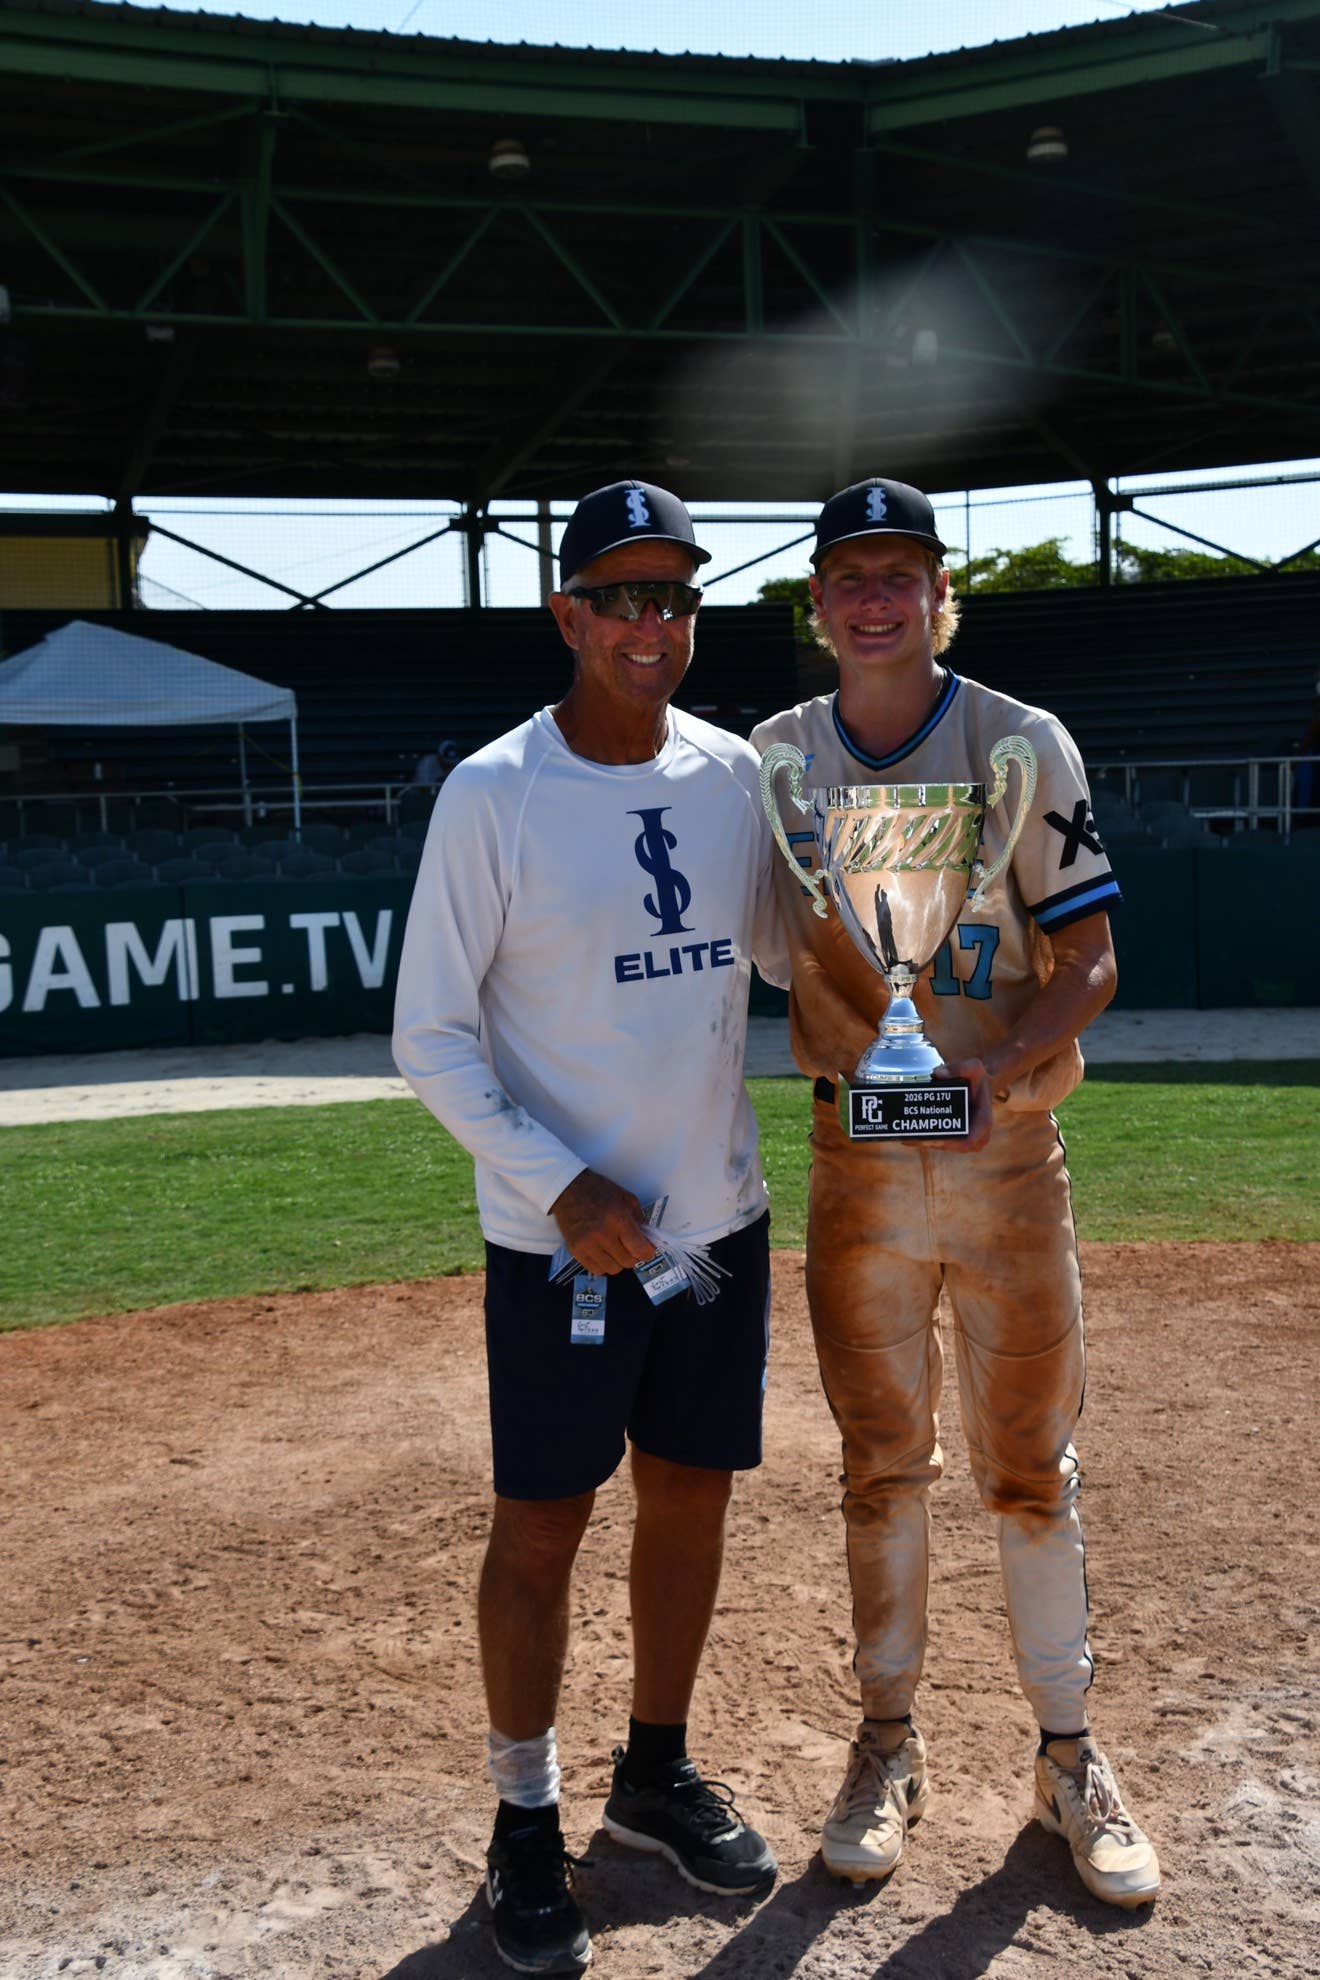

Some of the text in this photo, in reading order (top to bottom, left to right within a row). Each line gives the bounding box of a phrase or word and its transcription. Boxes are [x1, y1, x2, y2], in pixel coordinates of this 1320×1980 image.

[0, 910, 393, 1013] AME.TV
[614, 938, 735, 983] ELITE
[928, 924, 999, 1000] 17
[904, 1092, 951, 1102] 2026 PG 17U
[904, 1105, 952, 1115] BCS National
[892, 1118, 961, 1131] CHAMPION
[576, 1294, 602, 1303] BCS
